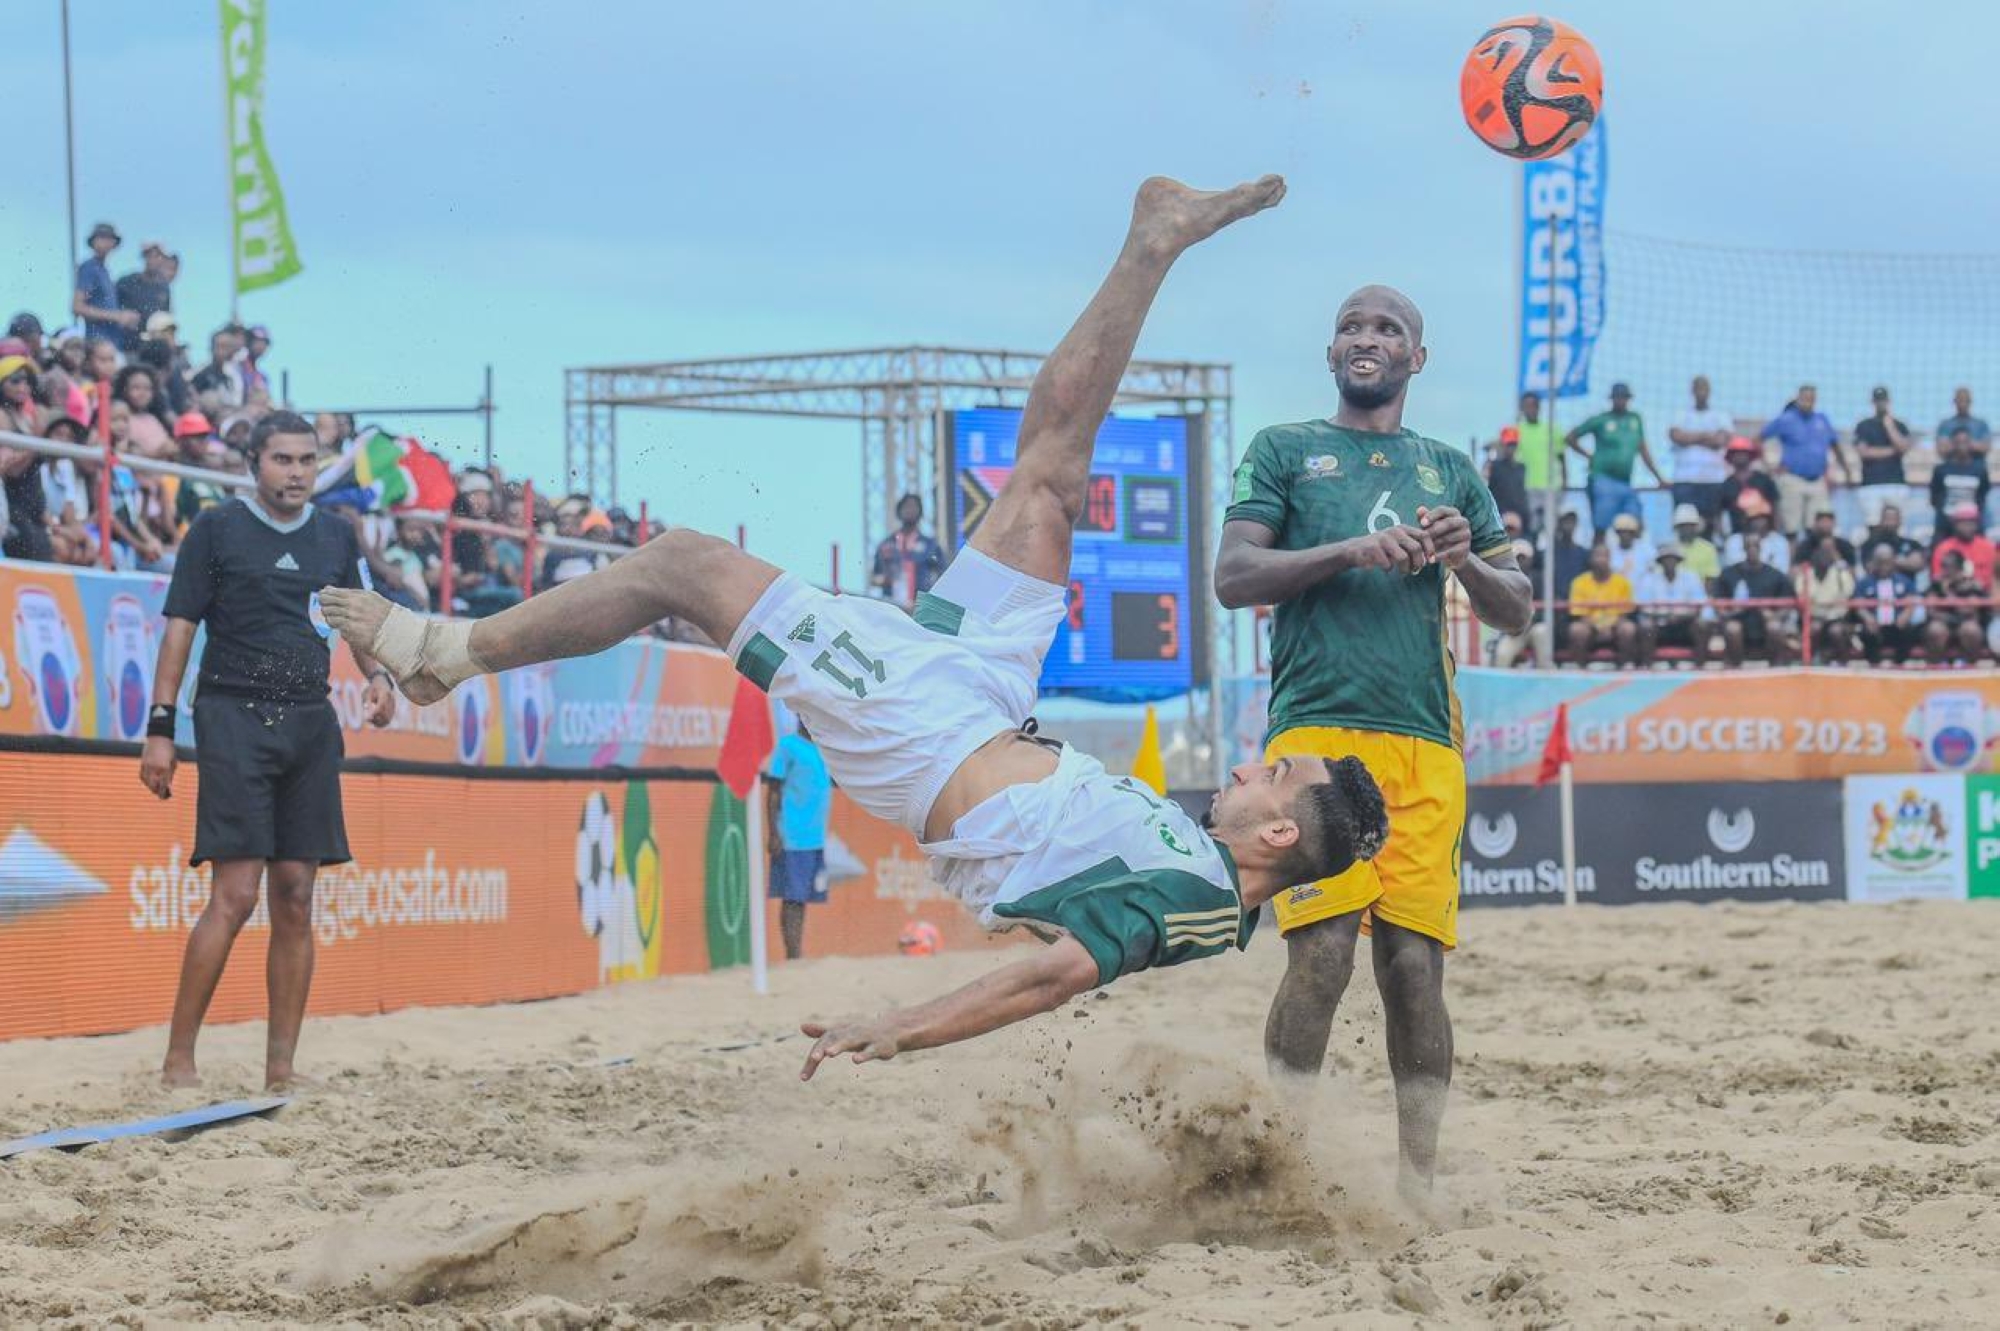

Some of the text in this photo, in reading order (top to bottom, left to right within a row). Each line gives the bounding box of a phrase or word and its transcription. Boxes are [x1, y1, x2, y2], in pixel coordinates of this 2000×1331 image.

[1528, 154, 1577, 391] DURB
[1367, 490, 1401, 534] 6
[787, 613, 816, 642] adidas
[1157, 593, 1179, 658] 3
[810, 629, 887, 700] 11
[1508, 720, 1626, 753] BECH
[1637, 717, 1783, 754] SOCCER
[1795, 720, 1888, 757] 2023
[129, 842, 508, 947] safeg@cosafa.com
[1461, 860, 1535, 895] hern
